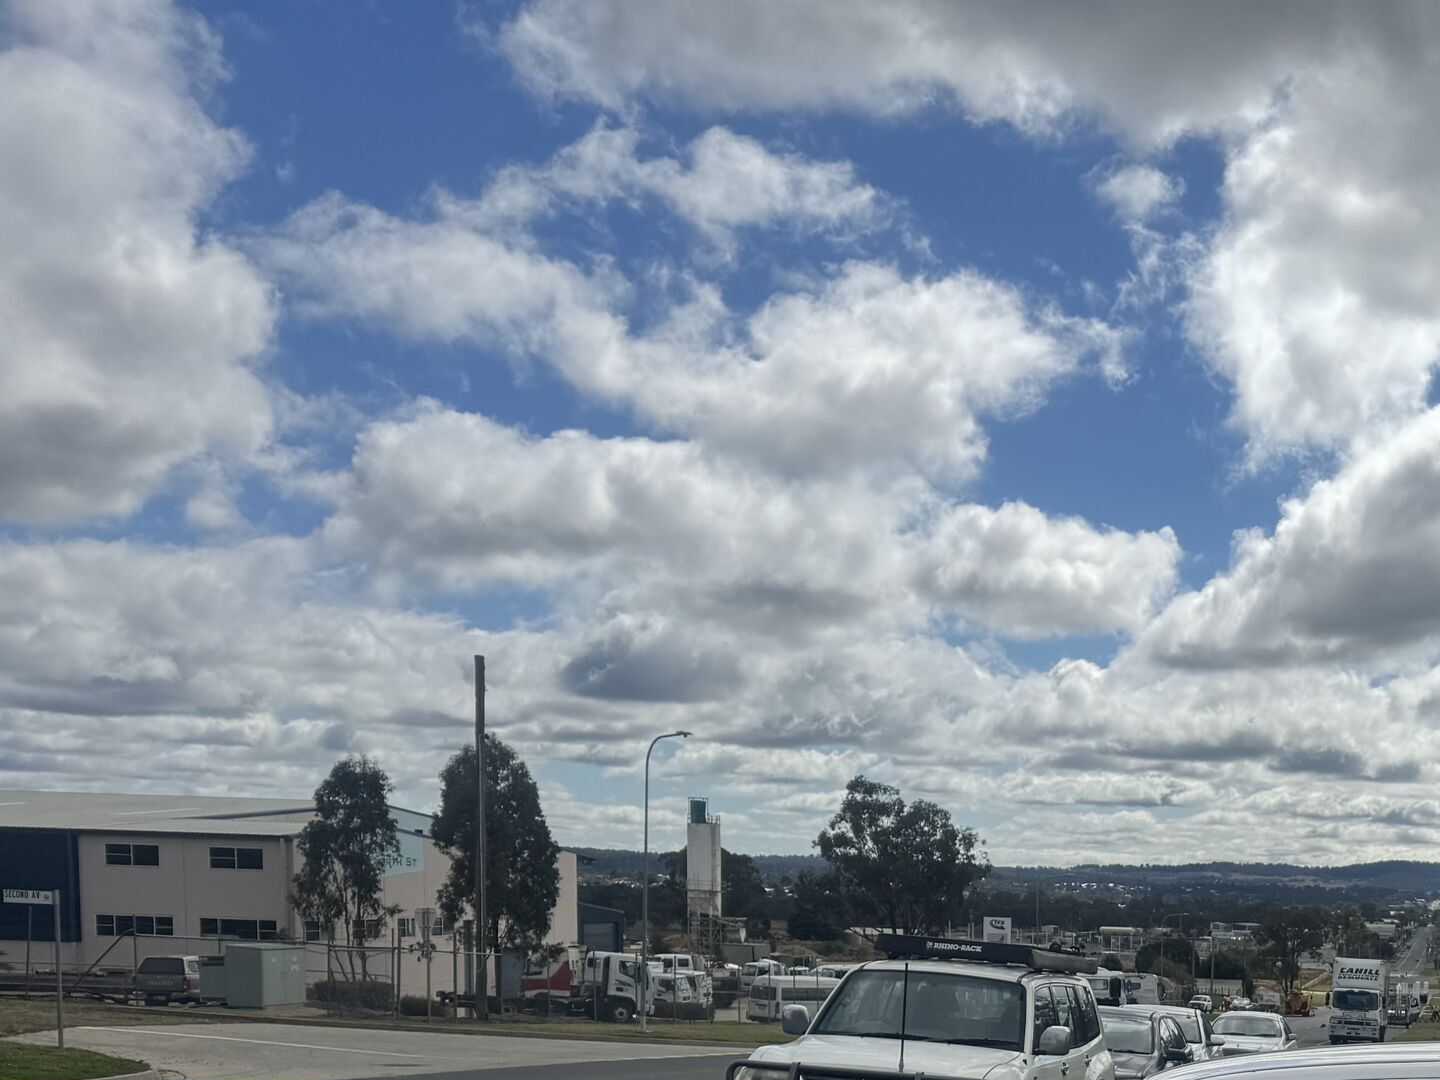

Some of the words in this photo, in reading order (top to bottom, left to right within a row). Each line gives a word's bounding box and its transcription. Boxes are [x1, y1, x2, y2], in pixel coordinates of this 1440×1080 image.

[4, 889, 29, 899] SECOND
[31, 890, 40, 899] AV
[933, 942, 982, 952] RHINO-RACK
[1340, 967, 1379, 976] CAHILL
